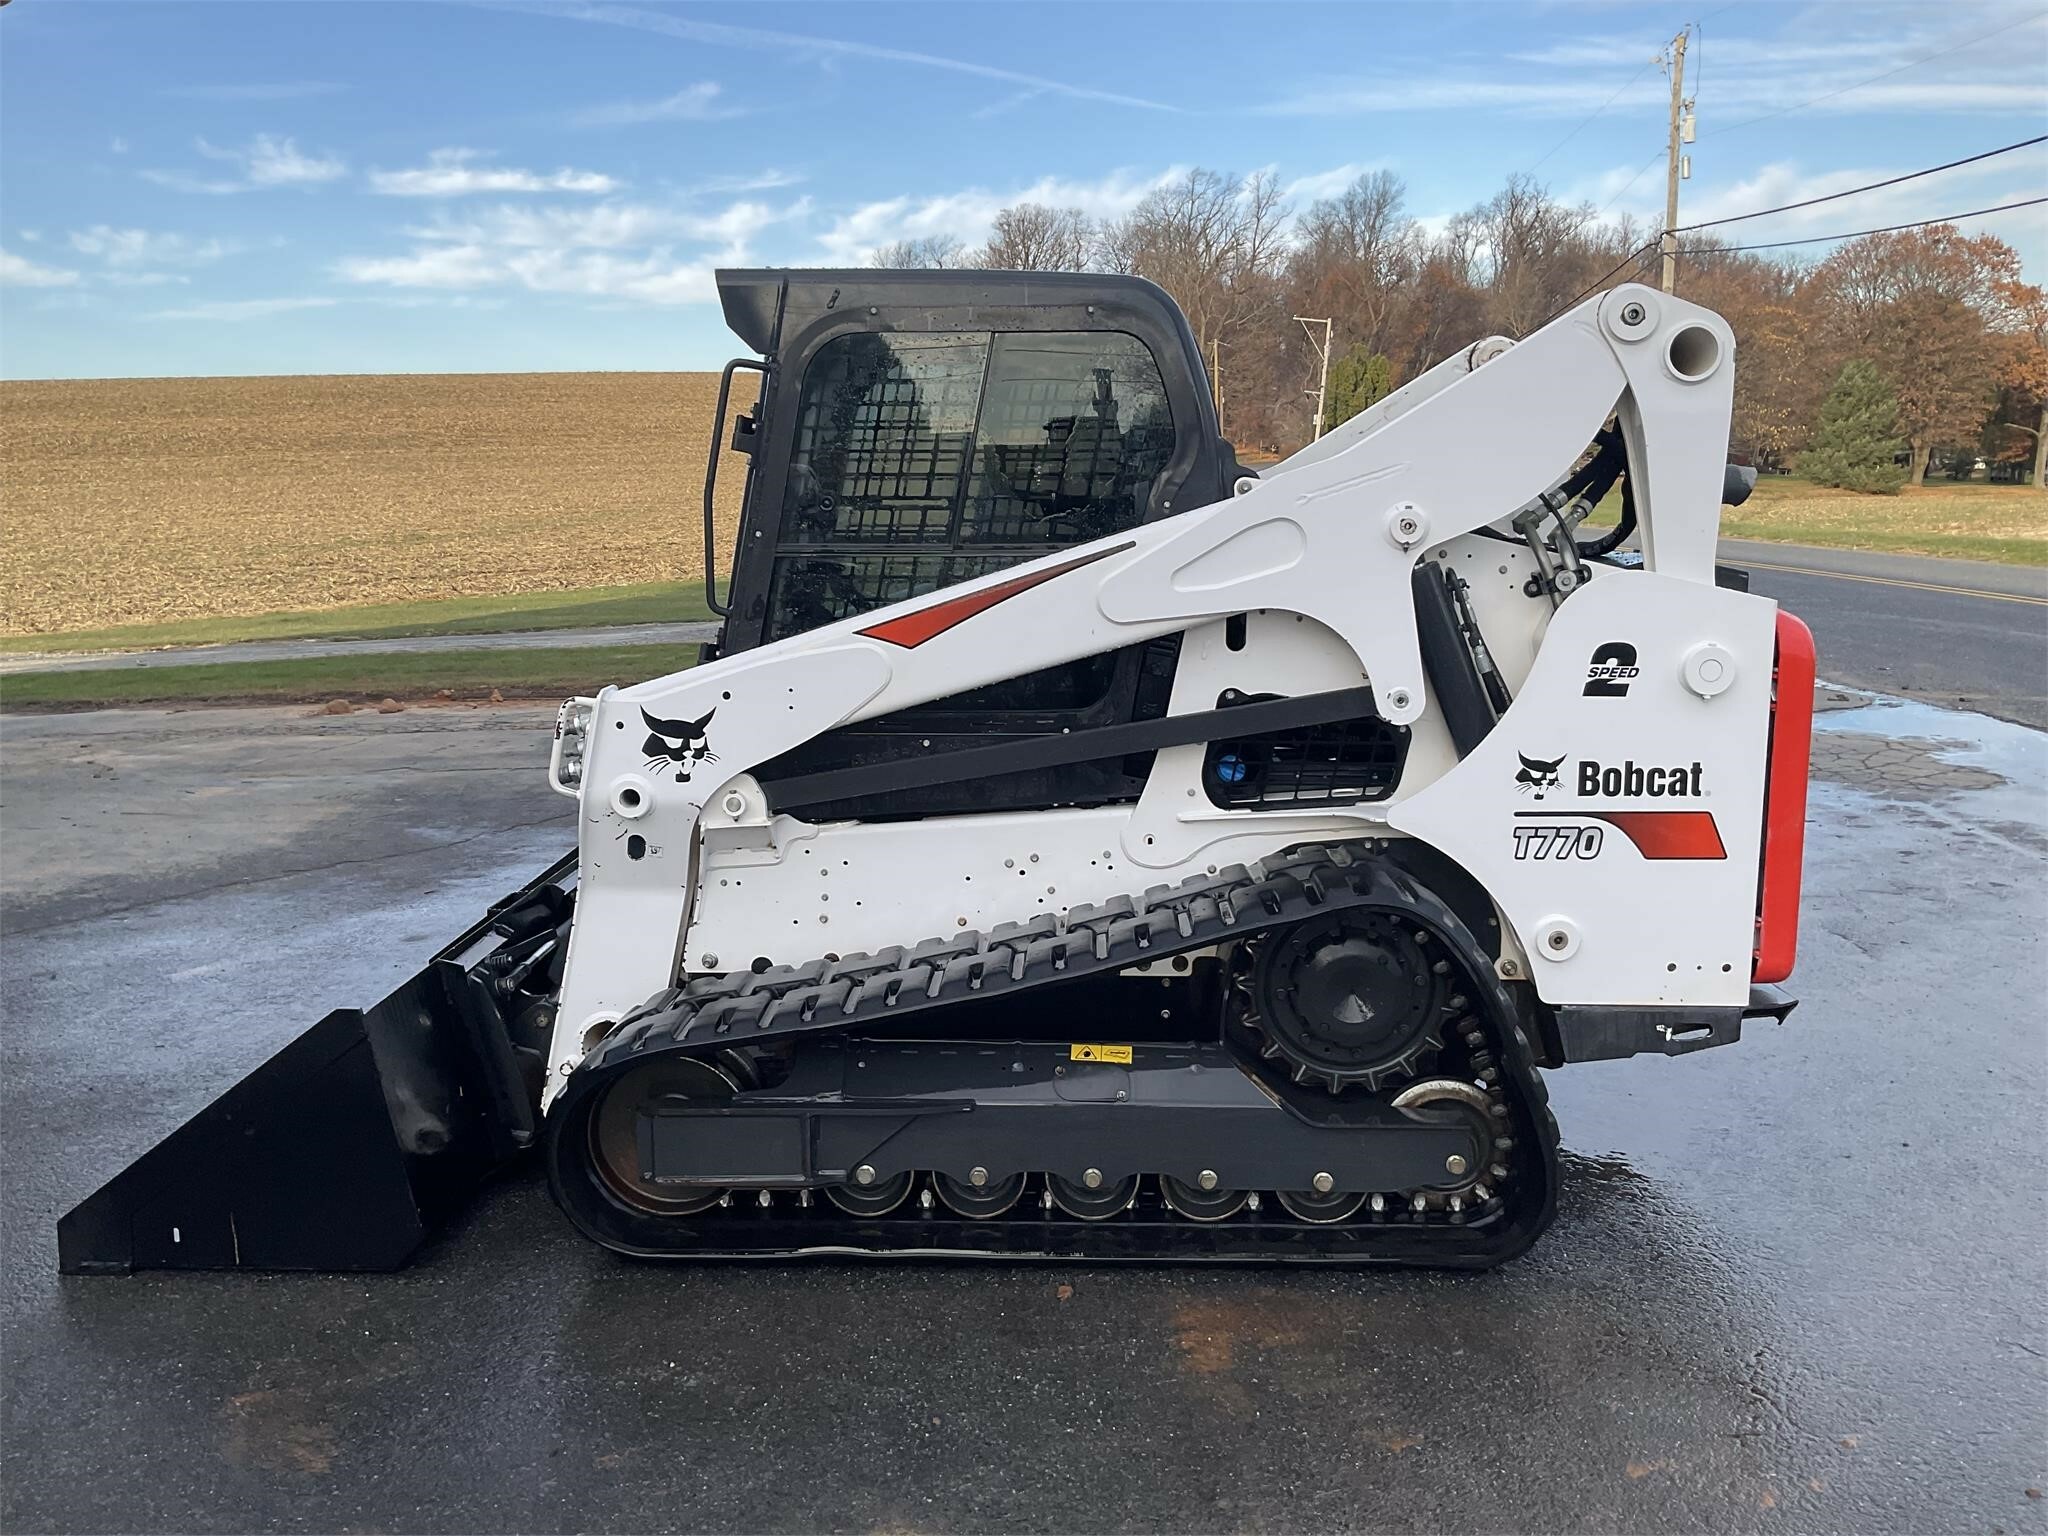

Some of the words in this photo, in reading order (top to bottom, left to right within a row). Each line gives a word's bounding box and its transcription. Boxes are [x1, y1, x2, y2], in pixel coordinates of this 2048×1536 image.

[1582, 642, 1637, 697] 2
[1587, 667, 1640, 678] SPEED
[1577, 761, 1703, 797] Bobcat
[1513, 826, 1603, 860] T770
